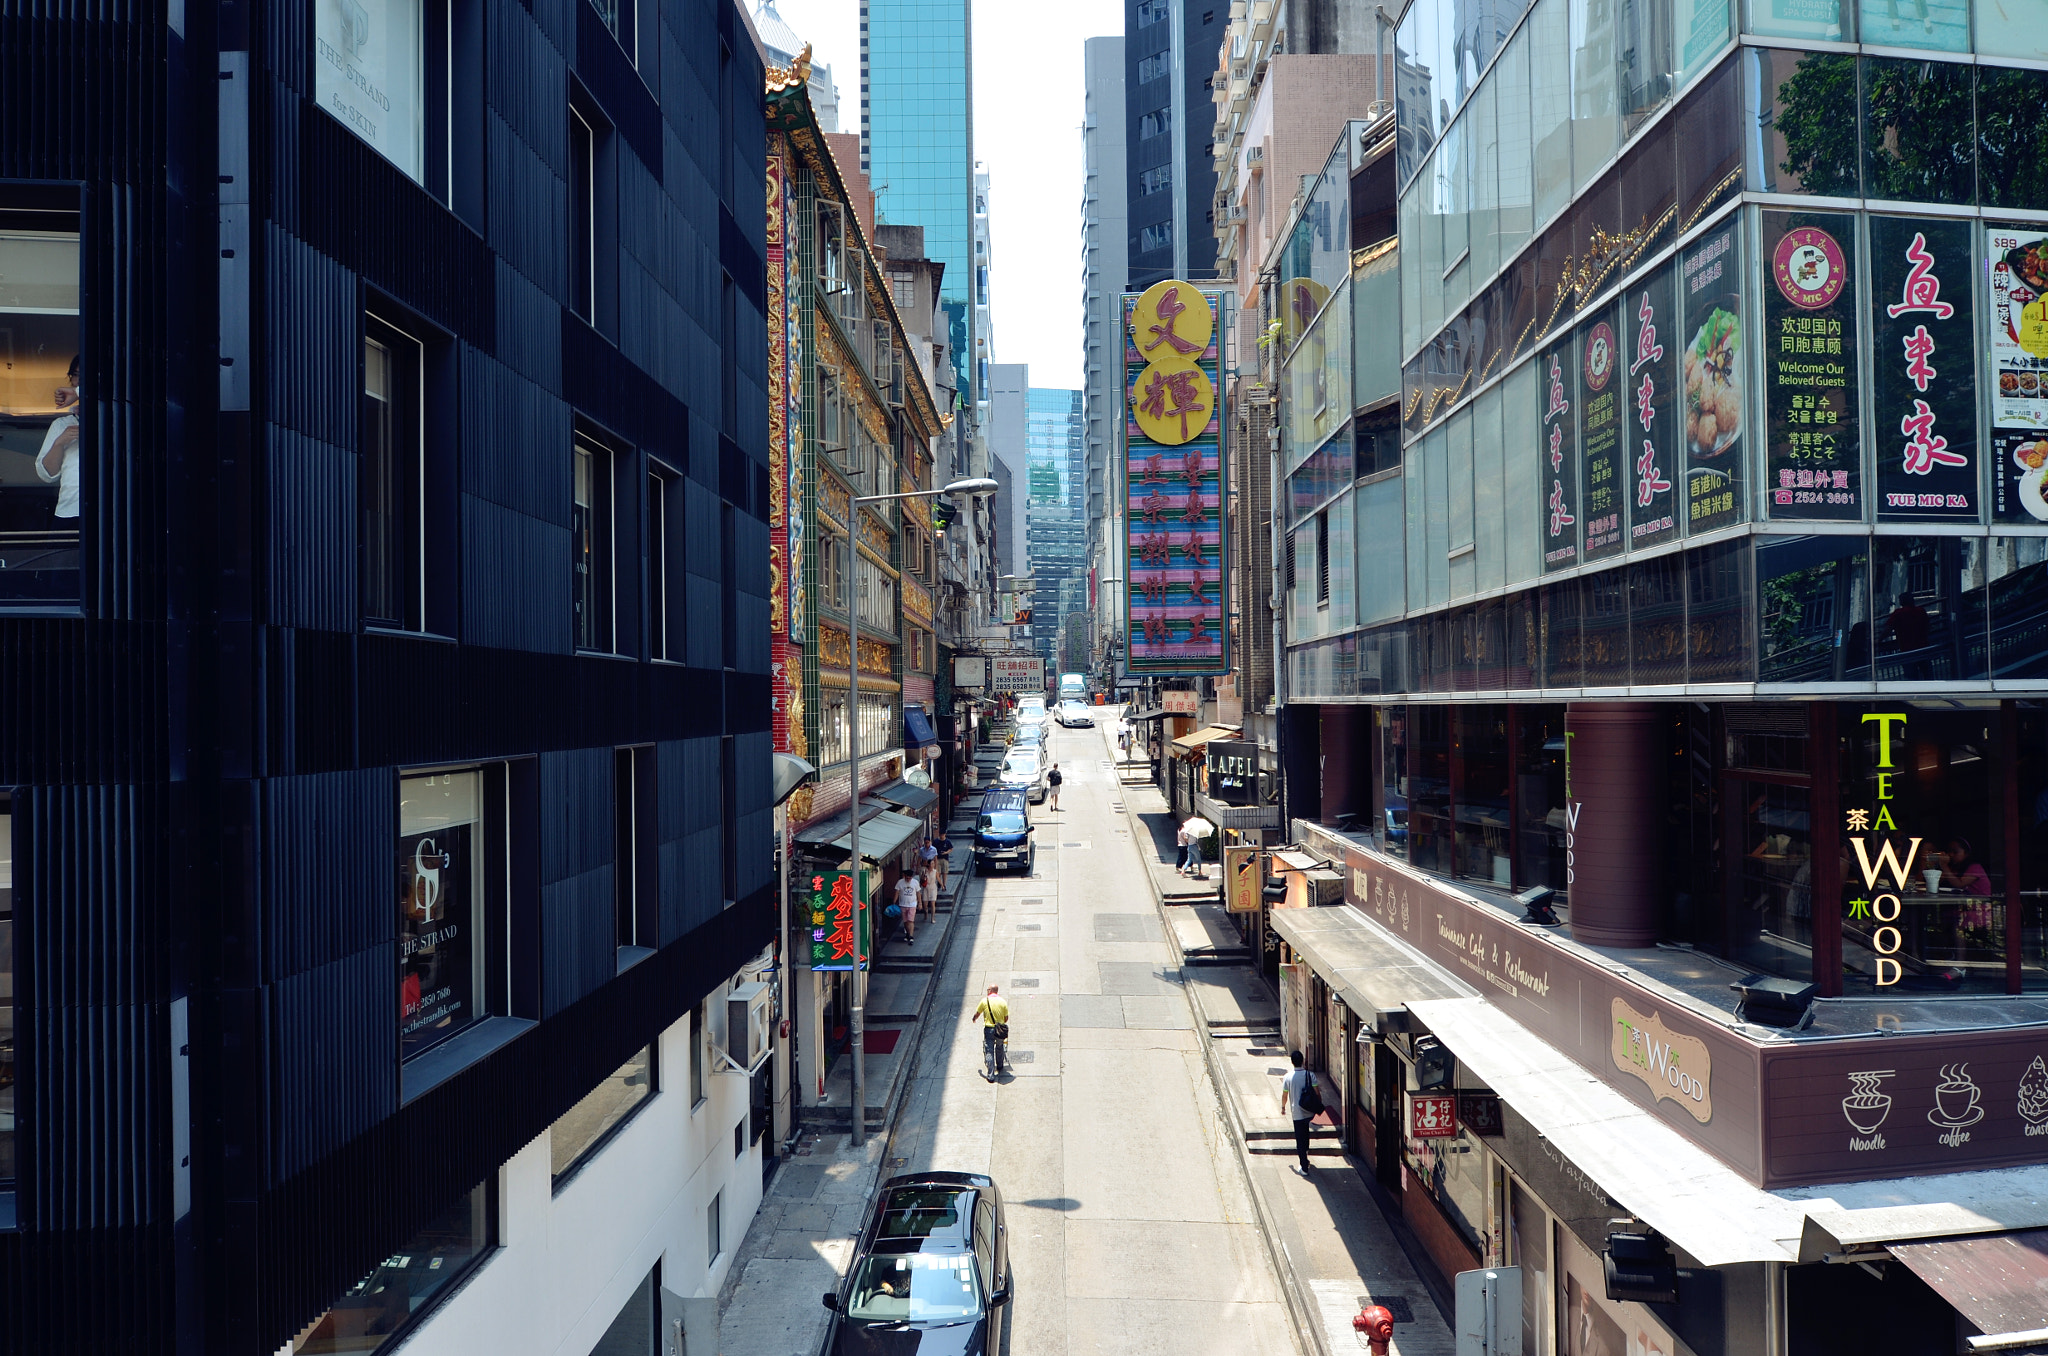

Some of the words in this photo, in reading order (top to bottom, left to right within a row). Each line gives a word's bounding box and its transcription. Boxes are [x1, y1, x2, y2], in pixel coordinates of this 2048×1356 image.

[1784, 8, 1800, 17] SPA
[318, 36, 343, 71] THE
[346, 63, 390, 112] STRAND
[332, 92, 347, 115] for
[348, 105, 376, 140] SKIN
[1994, 237, 2017, 249] $89
[1782, 275, 1800, 298] YUE
[1802, 294, 1822, 303] MIC
[1824, 279, 1838, 295] KA
[1781, 336, 1842, 354] 同胞惠顾
[1779, 362, 1824, 373] Welcome
[1826, 363, 1845, 374] Our
[1779, 375, 1813, 385] Beloved
[1816, 376, 1845, 387] Guests
[1792, 395, 1815, 409] 즐길
[1818, 396, 1831, 409] 수
[1788, 410, 1811, 424] 것을
[1814, 411, 1837, 424] 환영
[1587, 431, 1607, 446] Welcome
[1607, 428, 1615, 438] Our
[1789, 446, 1836, 459] ようこそ
[1779, 469, 1849, 489] 歡迎外賣
[1691, 492, 1733, 520] 魚湯米線
[1795, 491, 1824, 504] 2524
[1887, 494, 1915, 507] YUE
[1918, 495, 1943, 507] MIC
[1946, 495, 1968, 507] KA
[1632, 524, 1646, 538] YUE
[1646, 520, 1660, 532] MIC
[1660, 516, 1673, 529] KA
[1545, 551, 1556, 562] YUE
[1556, 548, 1566, 560] MIC
[1566, 545, 1575, 556] KA
[1145, 650, 1208, 660] Restaurant
[1209, 755, 1254, 777] LAPEL
[1861, 713, 1907, 831] TEA
[1846, 808, 1870, 832] 茶
[1848, 897, 1871, 920] 木
[1849, 837, 1923, 986] WOOD
[421, 924, 457, 949] STRAND
[1437, 914, 1466, 949] Taiwanese
[1469, 933, 1485, 966] Cafe
[1492, 943, 1498, 967] &
[1504, 950, 1550, 997] Restaurant
[406, 1002, 416, 1016] Tel
[420, 993, 436, 1008] 2850
[1632, 1026, 1641, 1045] 茶
[1670, 1050, 1680, 1069] 木
[1849, 1133, 1886, 1151] Noodle
[1938, 1126, 1971, 1147] coffee
